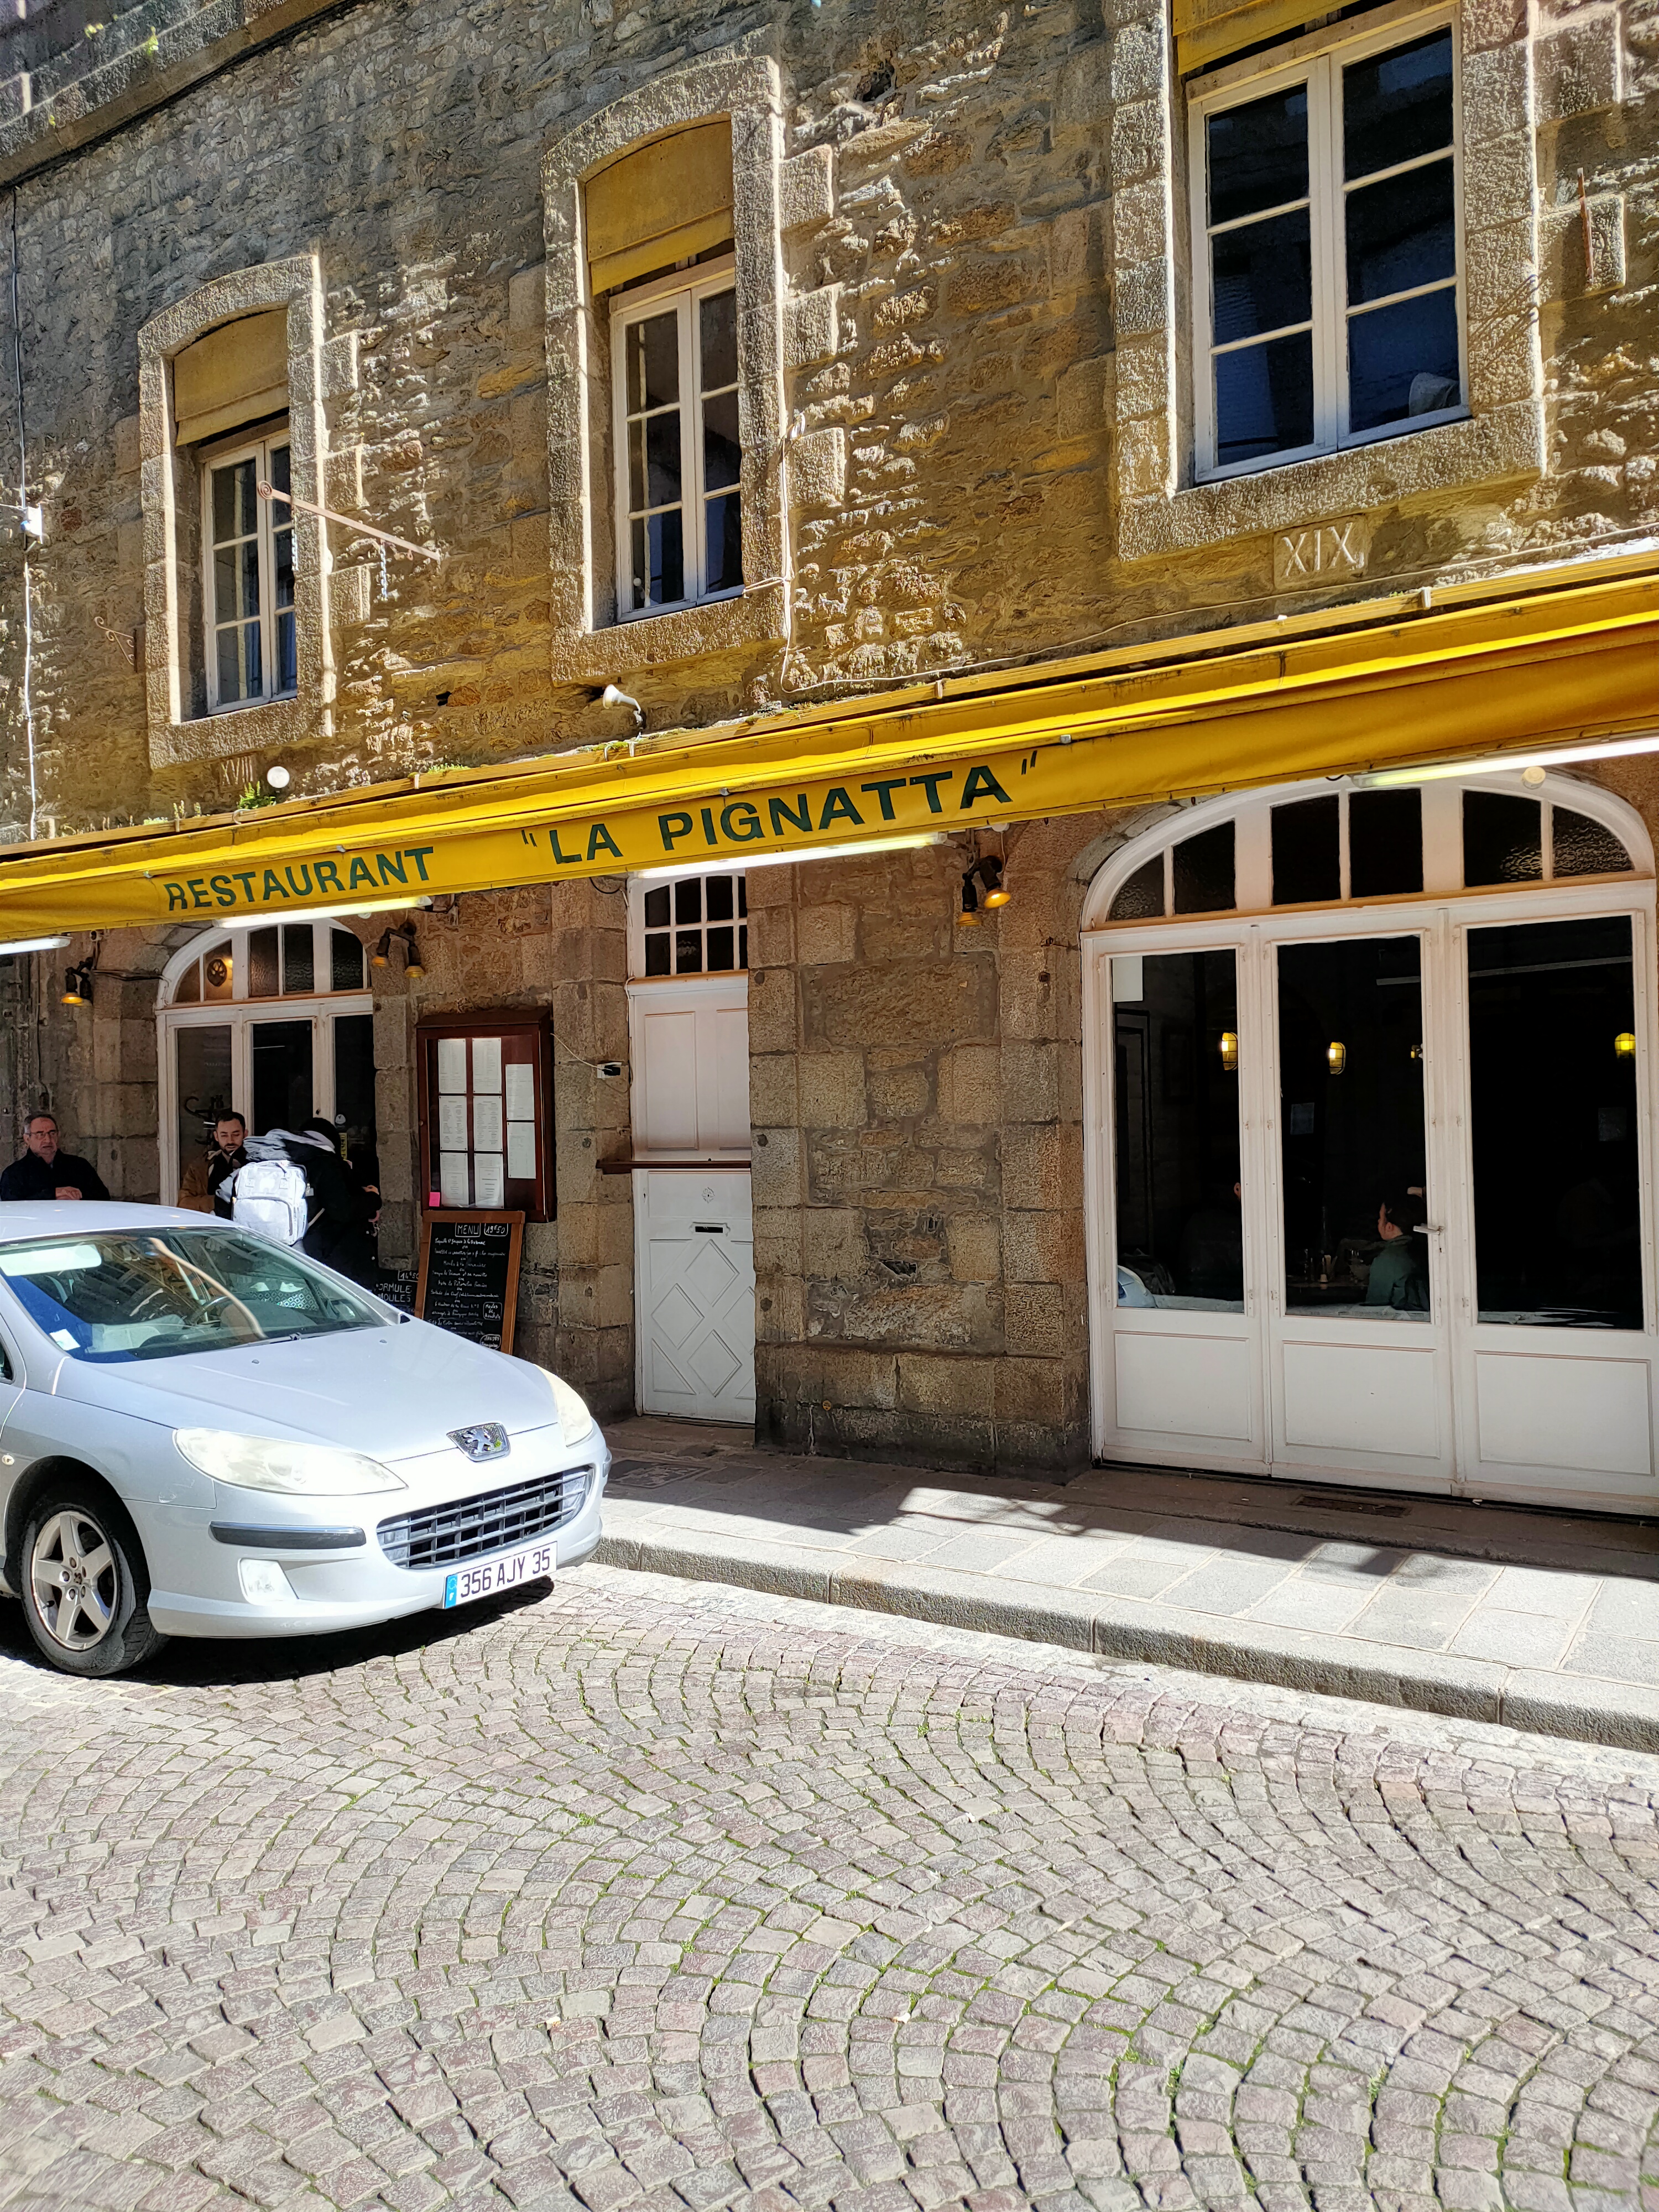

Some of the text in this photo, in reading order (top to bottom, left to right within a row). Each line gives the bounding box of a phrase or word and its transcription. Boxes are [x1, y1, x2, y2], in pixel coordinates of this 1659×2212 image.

[1281, 522, 1357, 577] XIX
[221, 755, 253, 785] XVIII
[163, 846, 434, 911] RESTAURANT
[457, 1225, 479, 1234] MENU
[461, 1547, 551, 1598] 356 AJY 35
